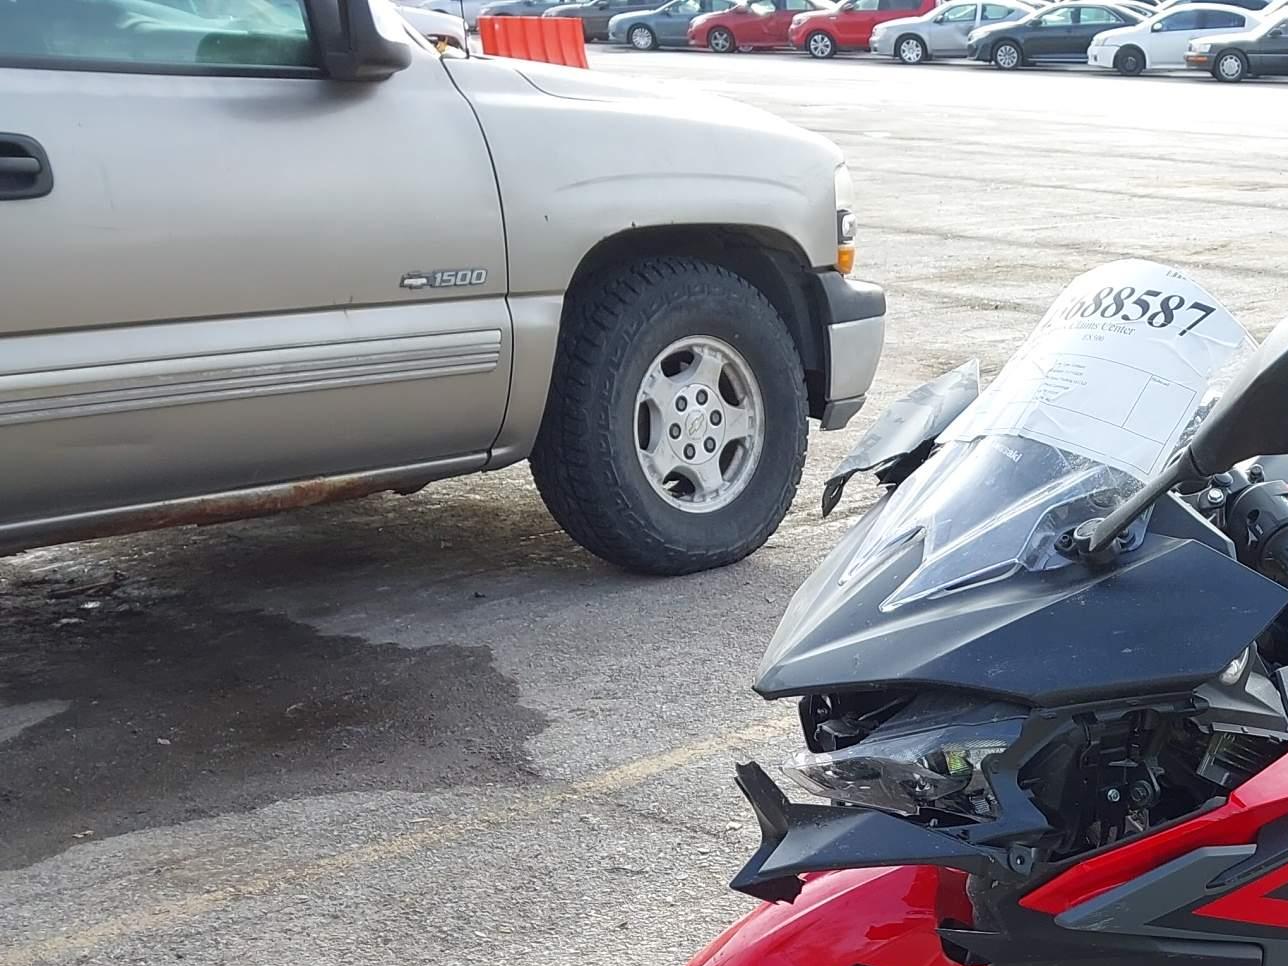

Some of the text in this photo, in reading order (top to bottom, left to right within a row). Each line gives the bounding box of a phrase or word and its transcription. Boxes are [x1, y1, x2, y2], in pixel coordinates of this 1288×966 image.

[434, 269, 487, 287] 1500
[1061, 287, 1216, 336] 688587
[1101, 322, 1136, 336] Center
